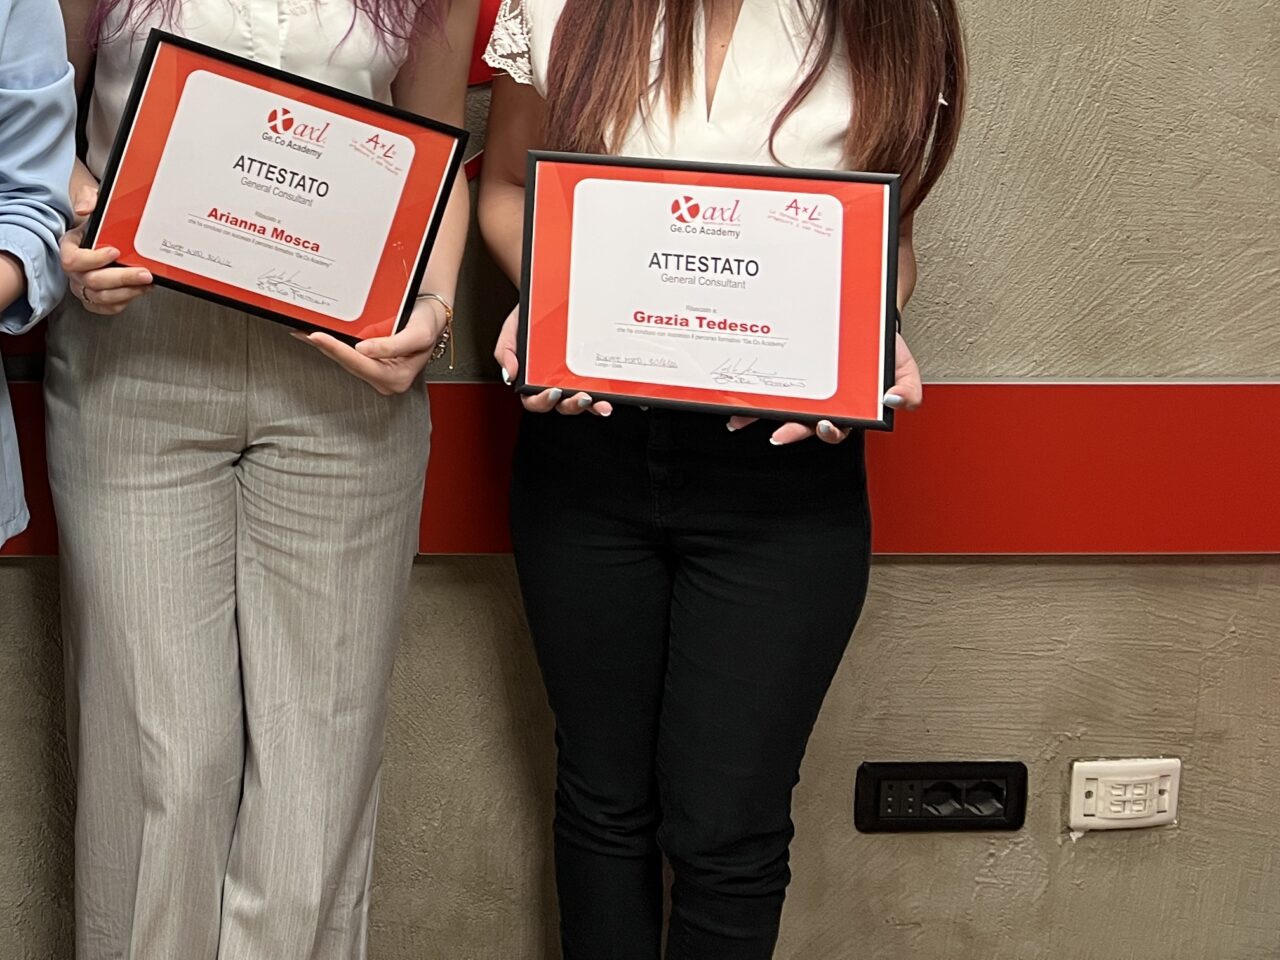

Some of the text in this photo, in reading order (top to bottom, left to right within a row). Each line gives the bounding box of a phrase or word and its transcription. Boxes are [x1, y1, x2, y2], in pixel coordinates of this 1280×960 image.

[287, 140, 322, 159] Academy
[232, 155, 329, 198] ATTESTATO
[241, 176, 314, 207] General Consultant
[208, 208, 266, 235] Arianna
[271, 227, 320, 252] Mosca
[699, 226, 740, 239] Academy
[648, 252, 759, 276] ATTESTATO
[661, 274, 746, 289] General Consultant
[634, 311, 770, 334] Grazia Tedesco
